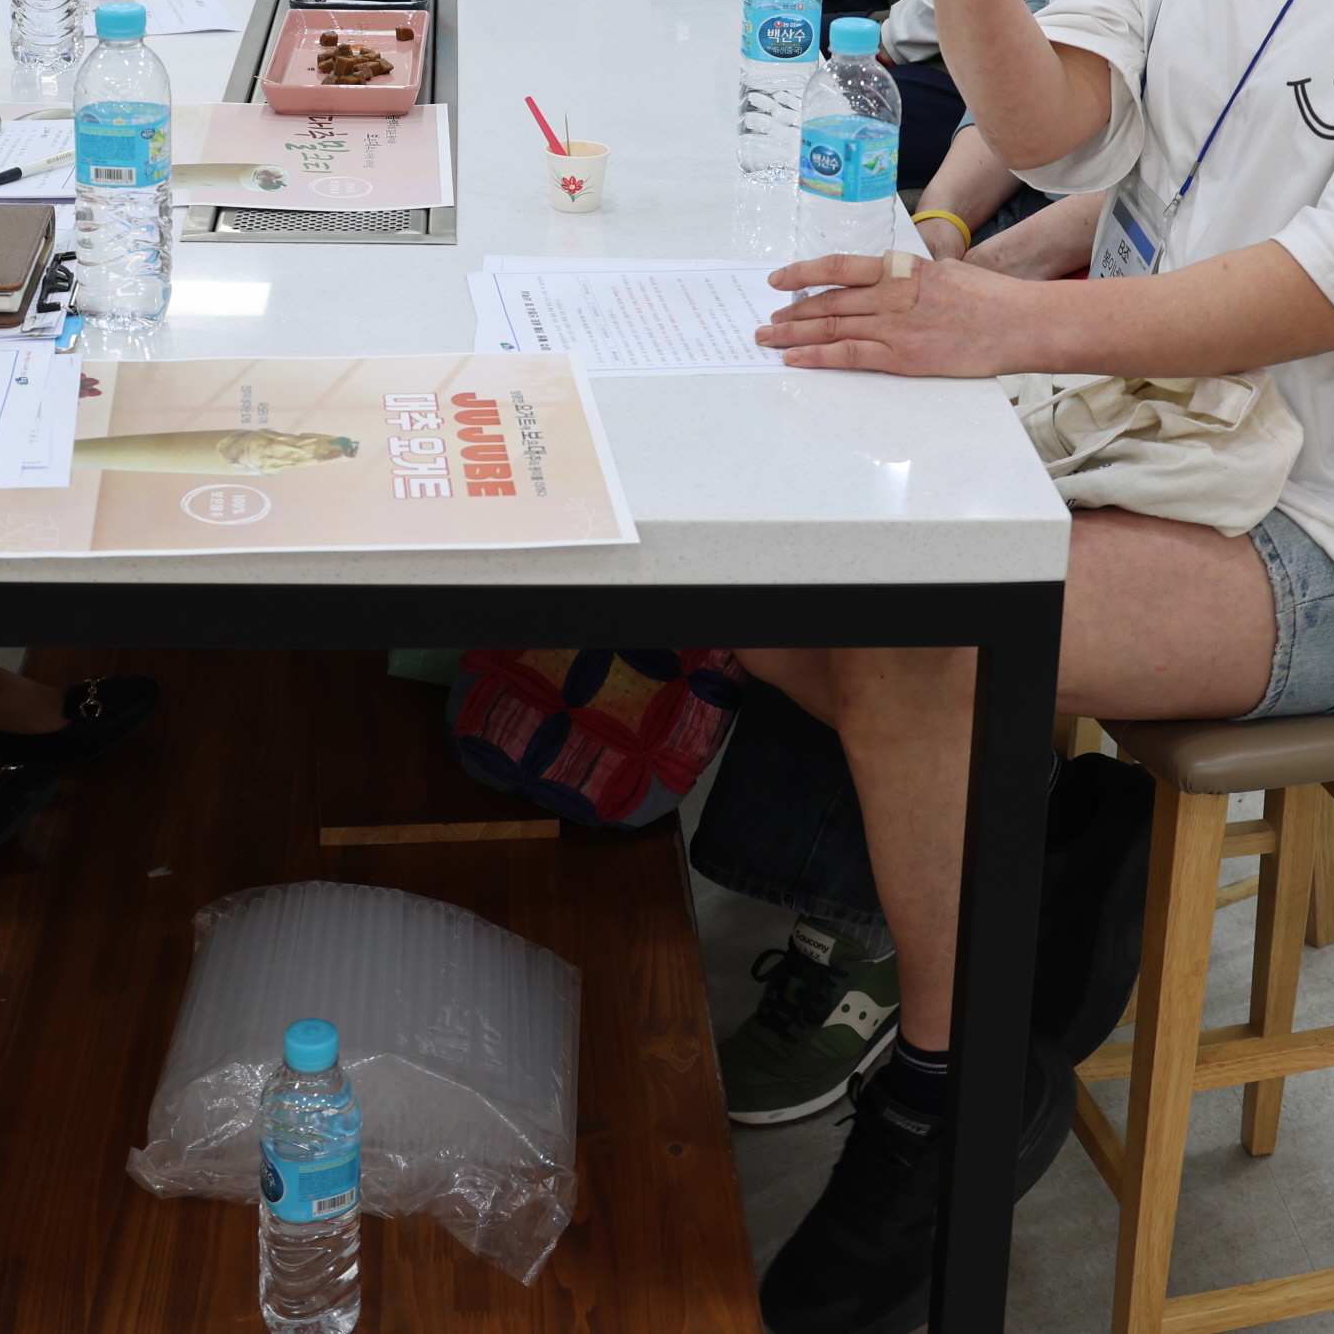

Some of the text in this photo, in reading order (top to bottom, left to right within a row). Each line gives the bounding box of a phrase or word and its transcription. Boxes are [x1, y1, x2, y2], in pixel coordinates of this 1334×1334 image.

[767, 29, 806, 43] 백산수
[812, 153, 839, 171] 백산수
[1118, 239, 1131, 264] B조
[515, 404, 536, 430] 요거트에
[383, 392, 453, 499] 대추 요거트
[450, 392, 517, 497] JUJUBE
[521, 431, 547, 466] 보은대추의
[209, 491, 225, 518] 보은대추
[232, 494, 246, 515] 100%
[795, 930, 829, 954] Saucony
